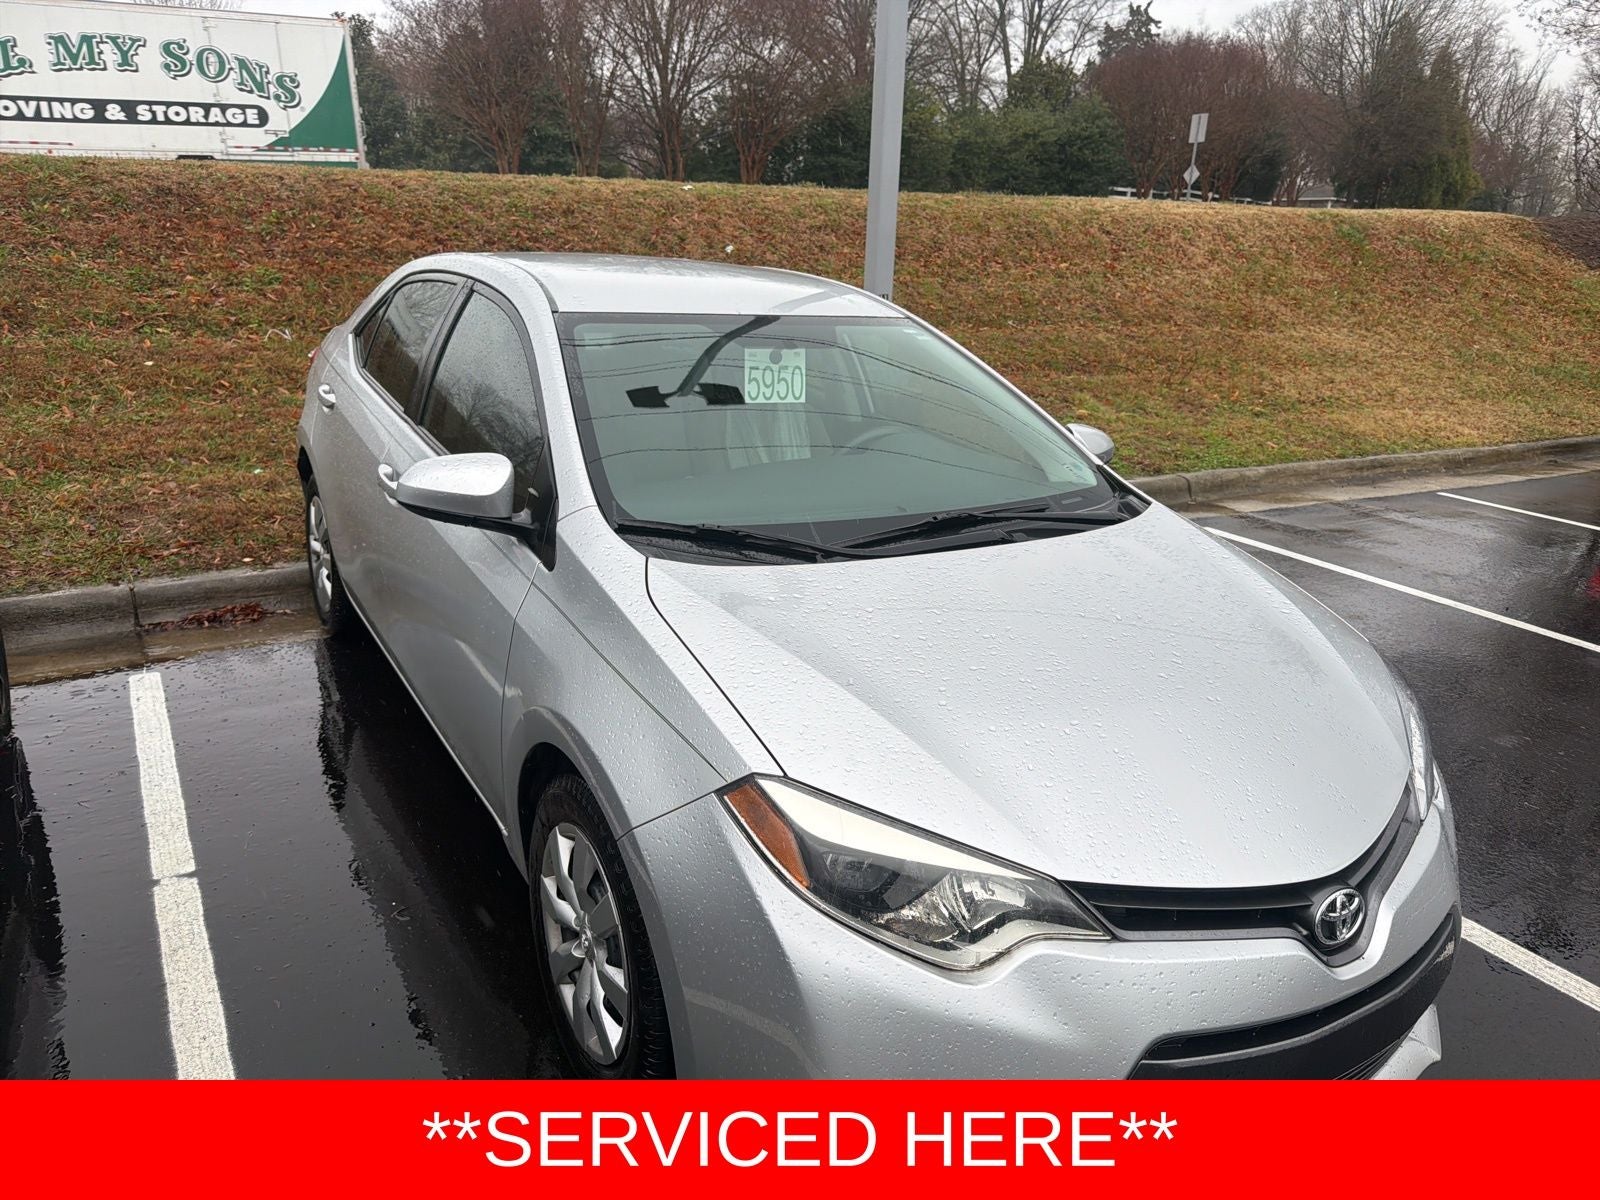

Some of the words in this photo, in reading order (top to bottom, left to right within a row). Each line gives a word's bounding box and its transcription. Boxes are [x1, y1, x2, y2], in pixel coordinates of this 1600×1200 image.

[45, 32, 146, 72] MY
[160, 38, 300, 110] SONS
[0, 100, 95, 120] OVING
[104, 103, 128, 120] &
[136, 104, 260, 125] STORAGE
[747, 365, 804, 401] 5950
